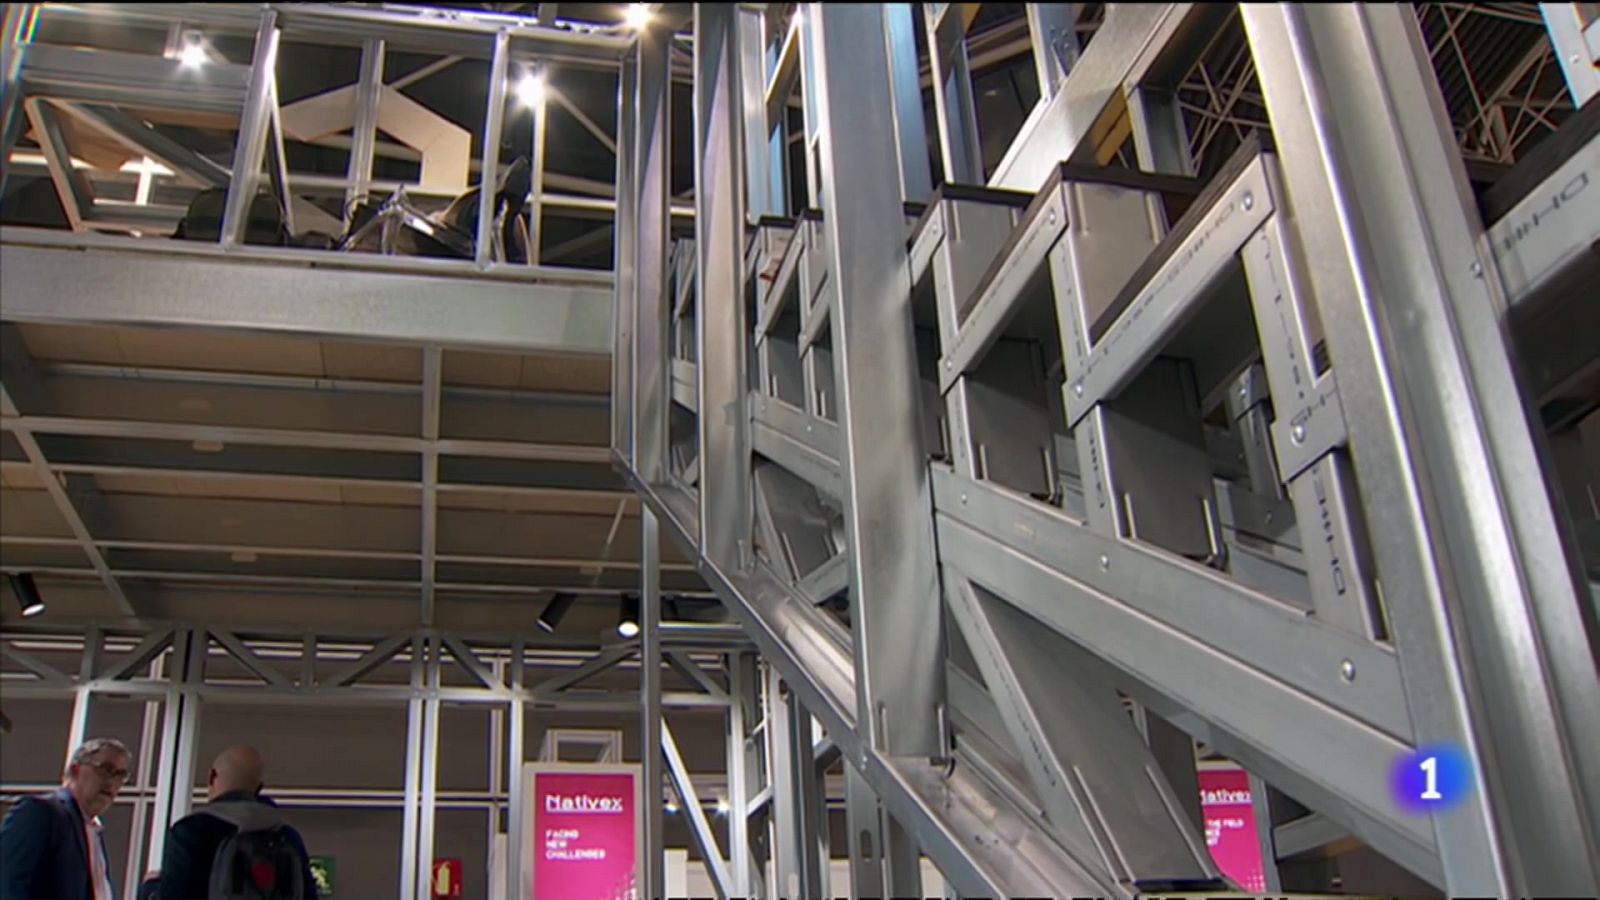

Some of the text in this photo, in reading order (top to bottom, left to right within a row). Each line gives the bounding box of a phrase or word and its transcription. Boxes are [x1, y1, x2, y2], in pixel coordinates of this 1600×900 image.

[545, 795, 624, 812] Nativex
[545, 829, 579, 839] FACING
[545, 840, 567, 849] NEW
[545, 849, 606, 860] CHALLENGES
